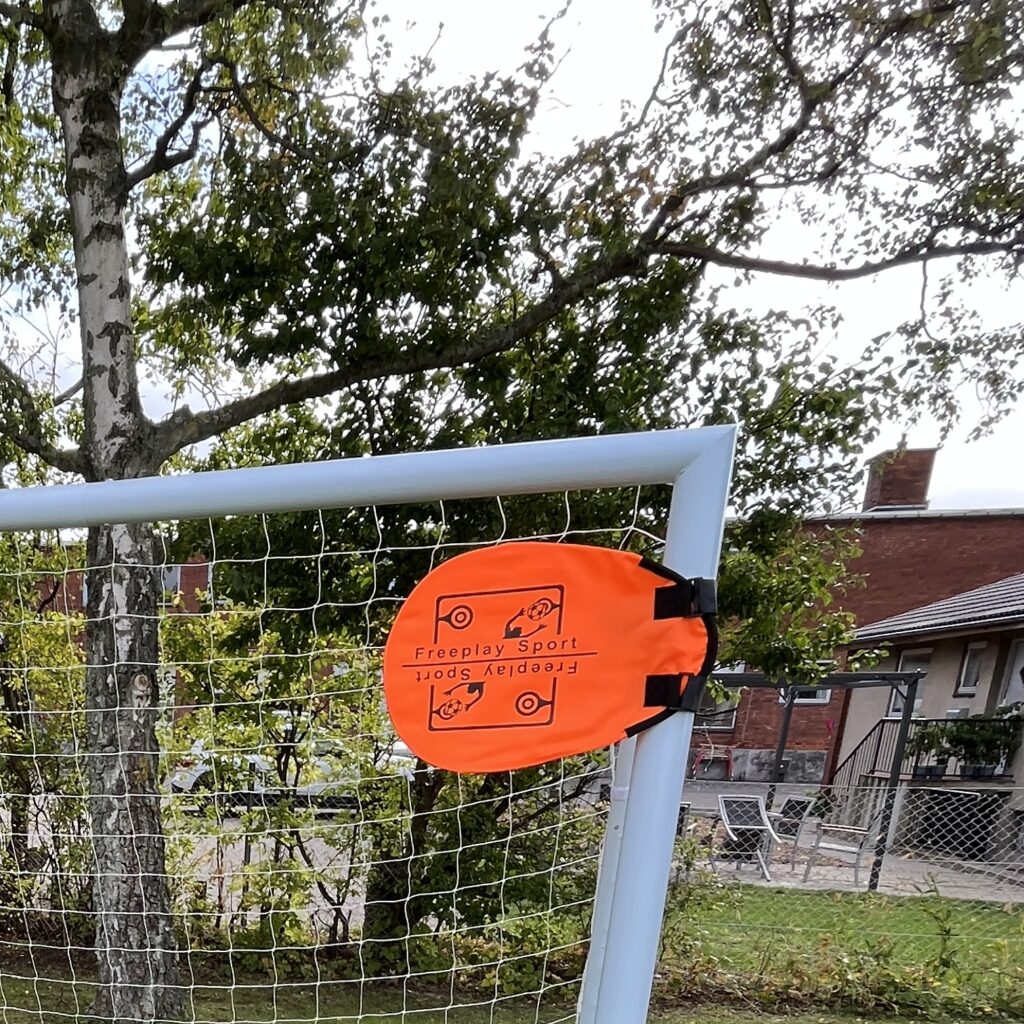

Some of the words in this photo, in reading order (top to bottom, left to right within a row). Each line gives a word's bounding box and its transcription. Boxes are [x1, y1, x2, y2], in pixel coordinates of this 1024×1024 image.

[415, 644, 504, 660] Freeplay
[518, 637, 577, 654] Sport
[416, 667, 471, 682] Sport
[484, 661, 578, 677] Freeplay
